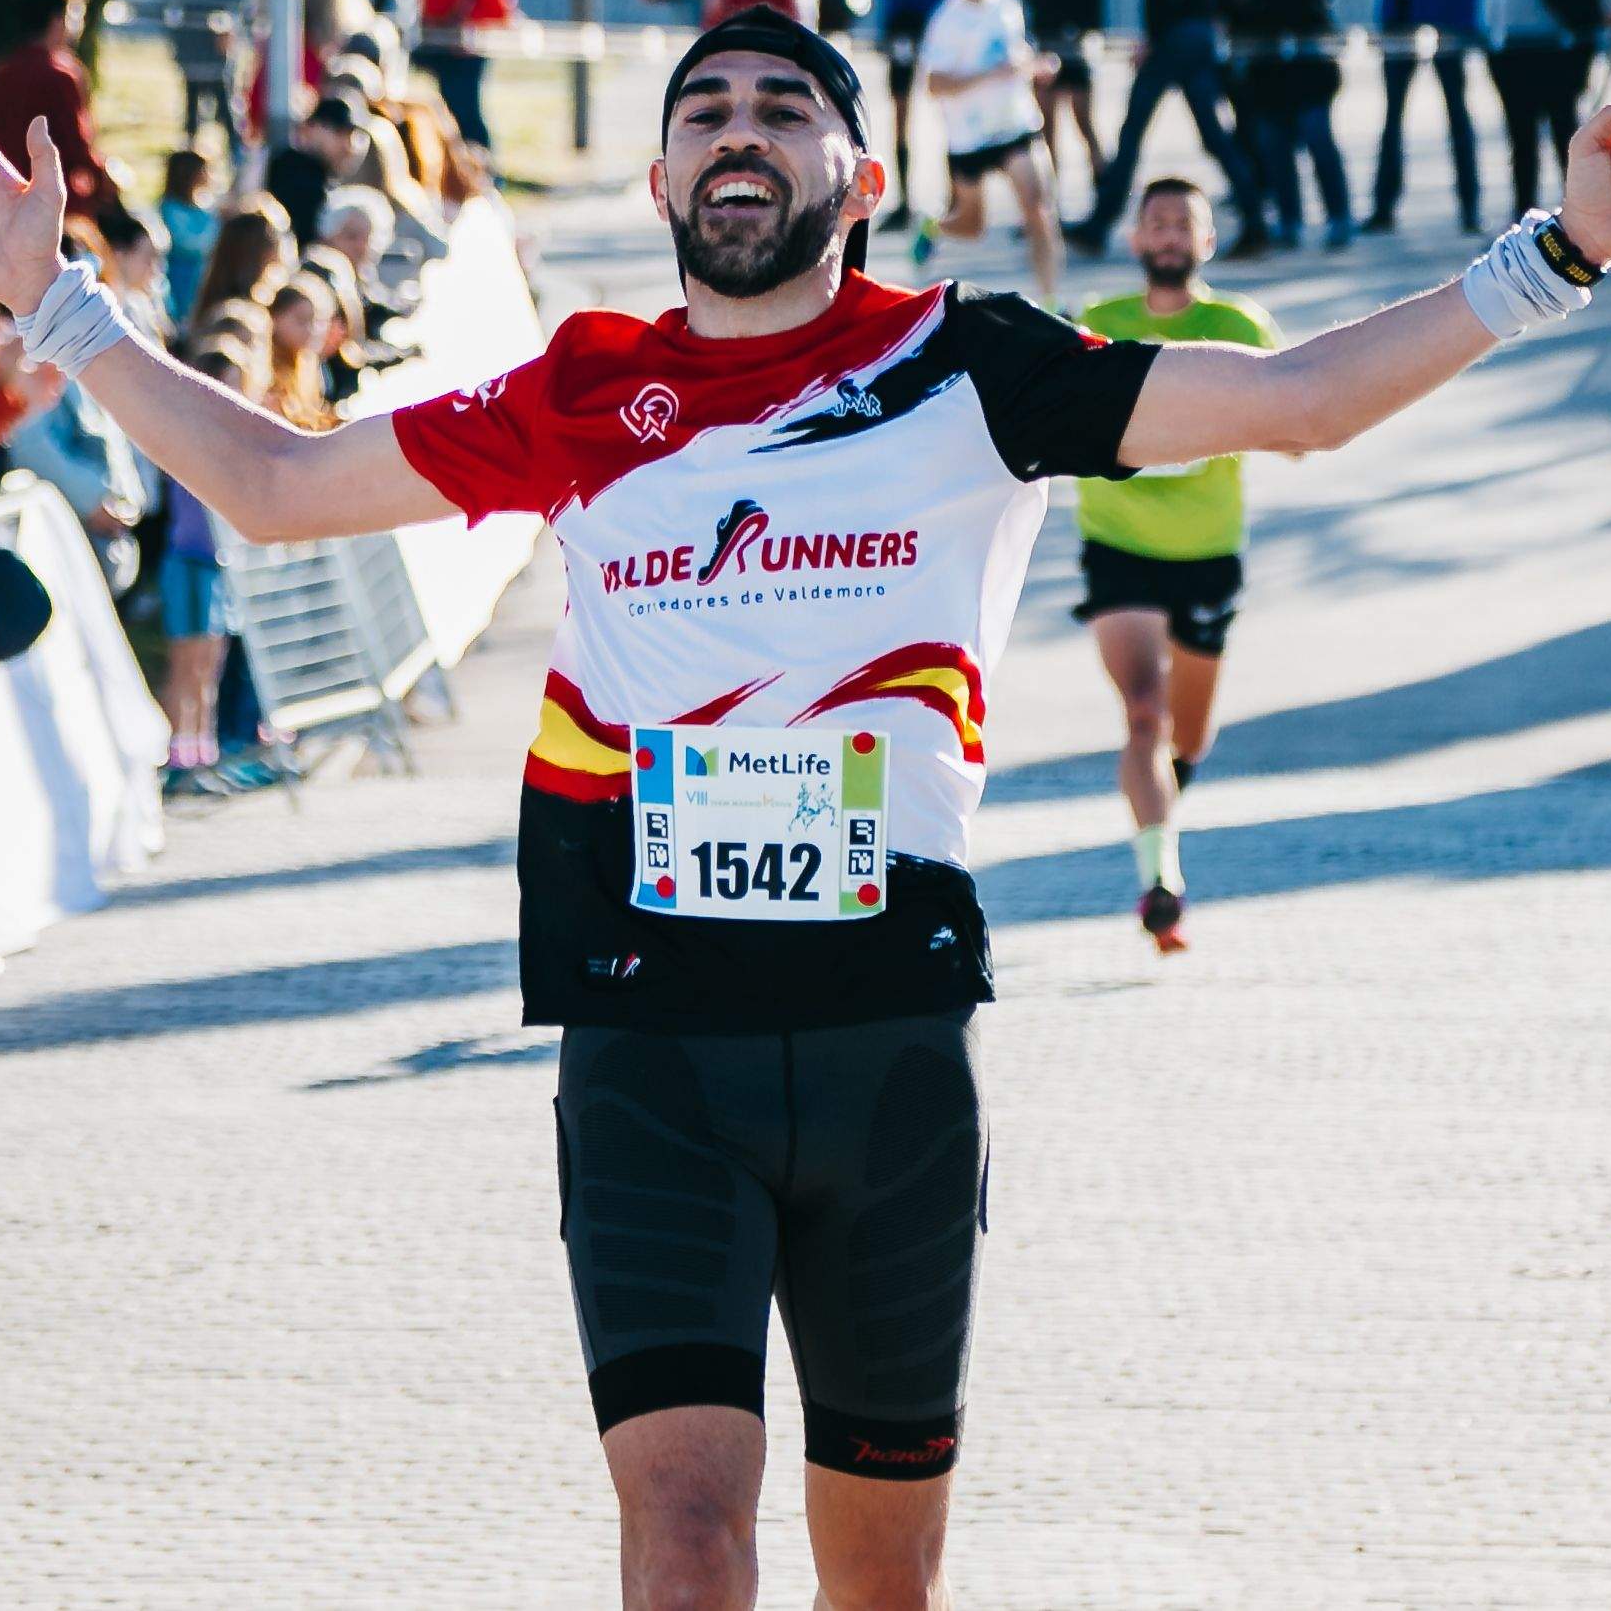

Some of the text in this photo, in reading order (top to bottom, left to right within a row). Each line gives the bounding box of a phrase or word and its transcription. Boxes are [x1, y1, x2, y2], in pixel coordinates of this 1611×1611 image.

[740, 589, 765, 605] de
[774, 584, 886, 603] Valdemoro
[728, 751, 832, 776] MetLife
[690, 840, 823, 902] 1542
